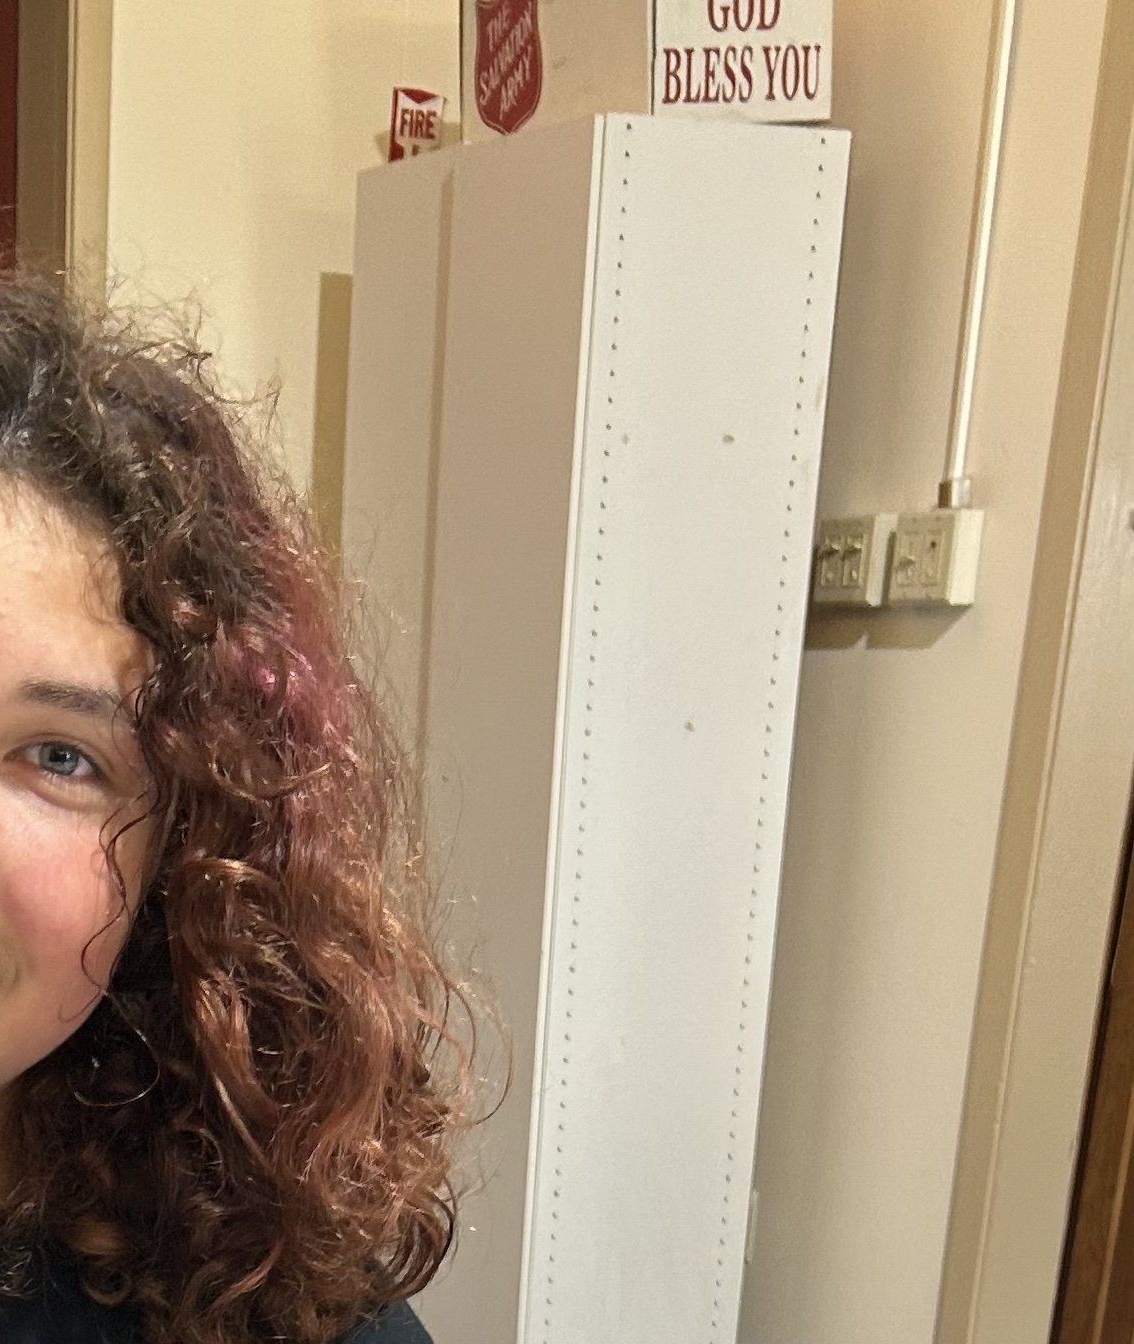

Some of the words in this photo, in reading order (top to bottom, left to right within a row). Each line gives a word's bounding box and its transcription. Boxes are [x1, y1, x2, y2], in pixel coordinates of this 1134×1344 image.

[498, 45, 532, 121] ARMY
[662, 44, 754, 104] BLESS
[762, 43, 821, 101] YOU
[399, 108, 437, 140] FIRE
